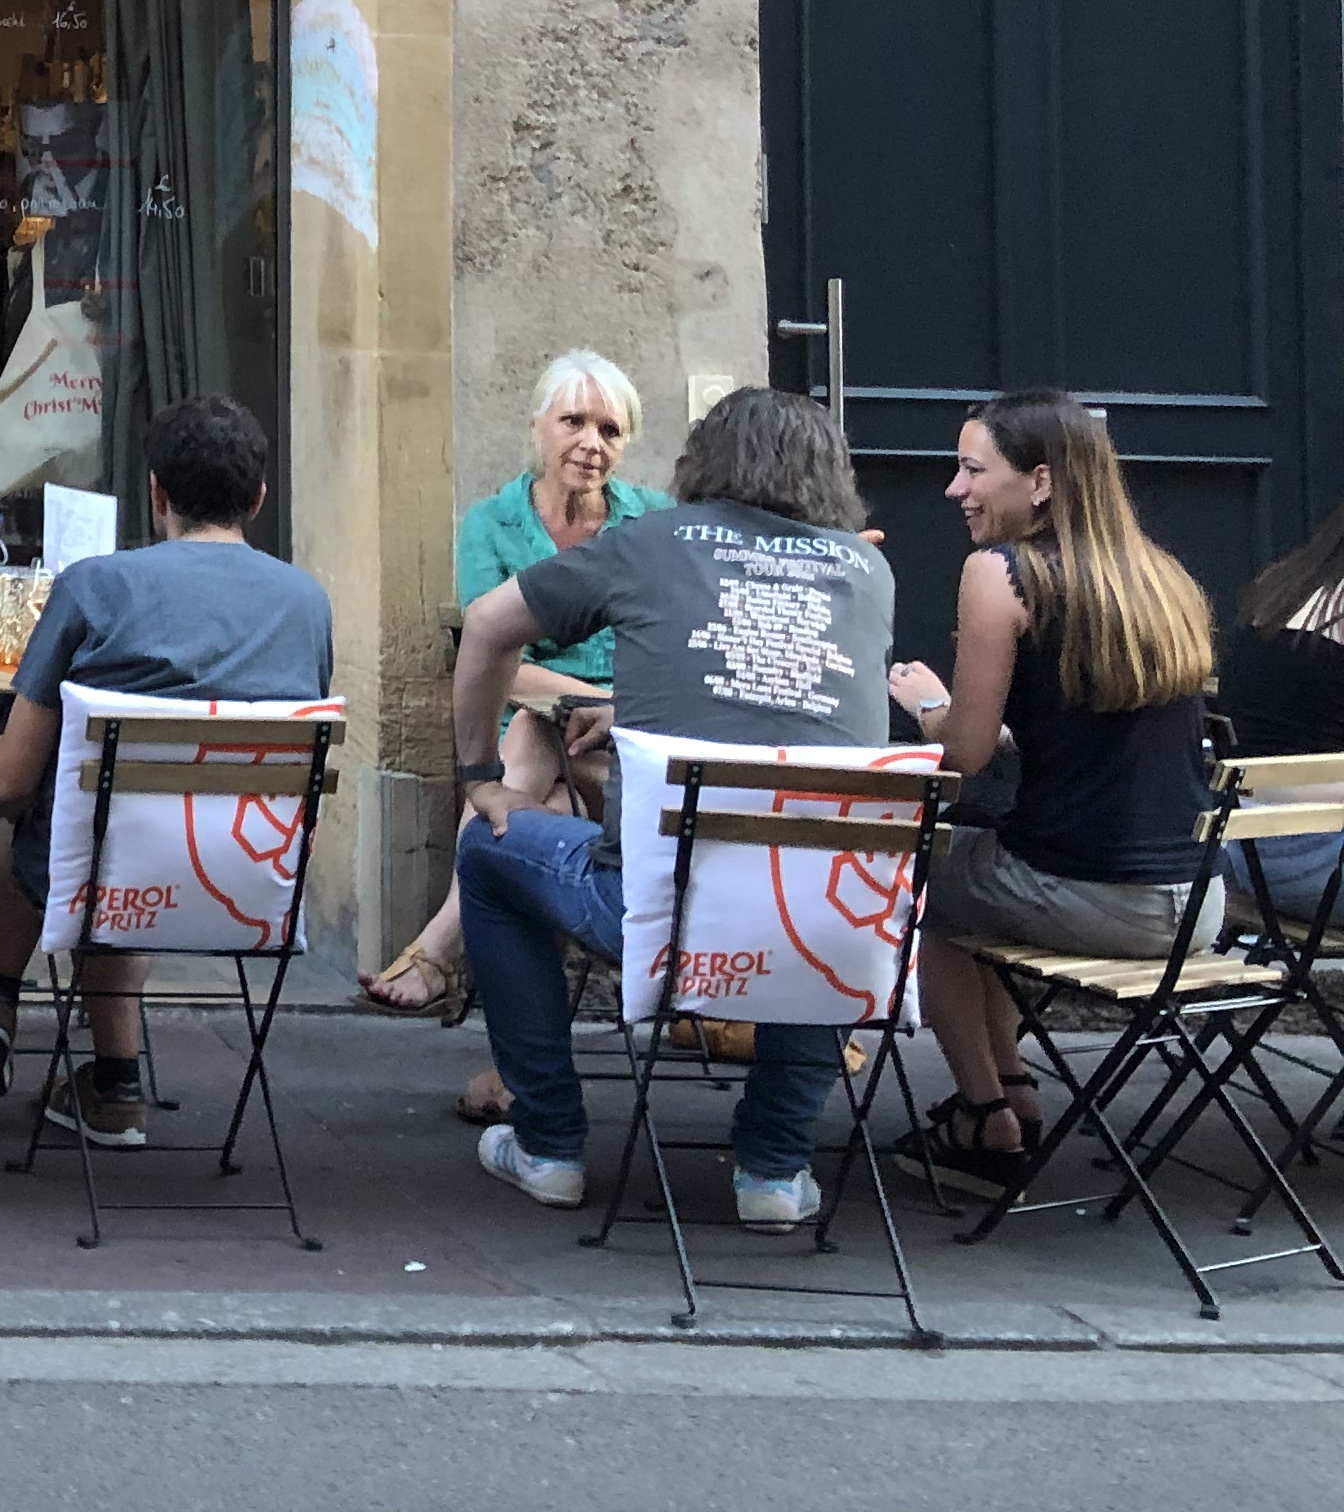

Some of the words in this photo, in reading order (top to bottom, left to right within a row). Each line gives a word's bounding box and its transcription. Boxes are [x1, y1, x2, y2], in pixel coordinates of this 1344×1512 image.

[754, 535, 872, 575] MISSION
[91, 909, 158, 932] PRITZ
[672, 974, 750, 999] PRITZ
